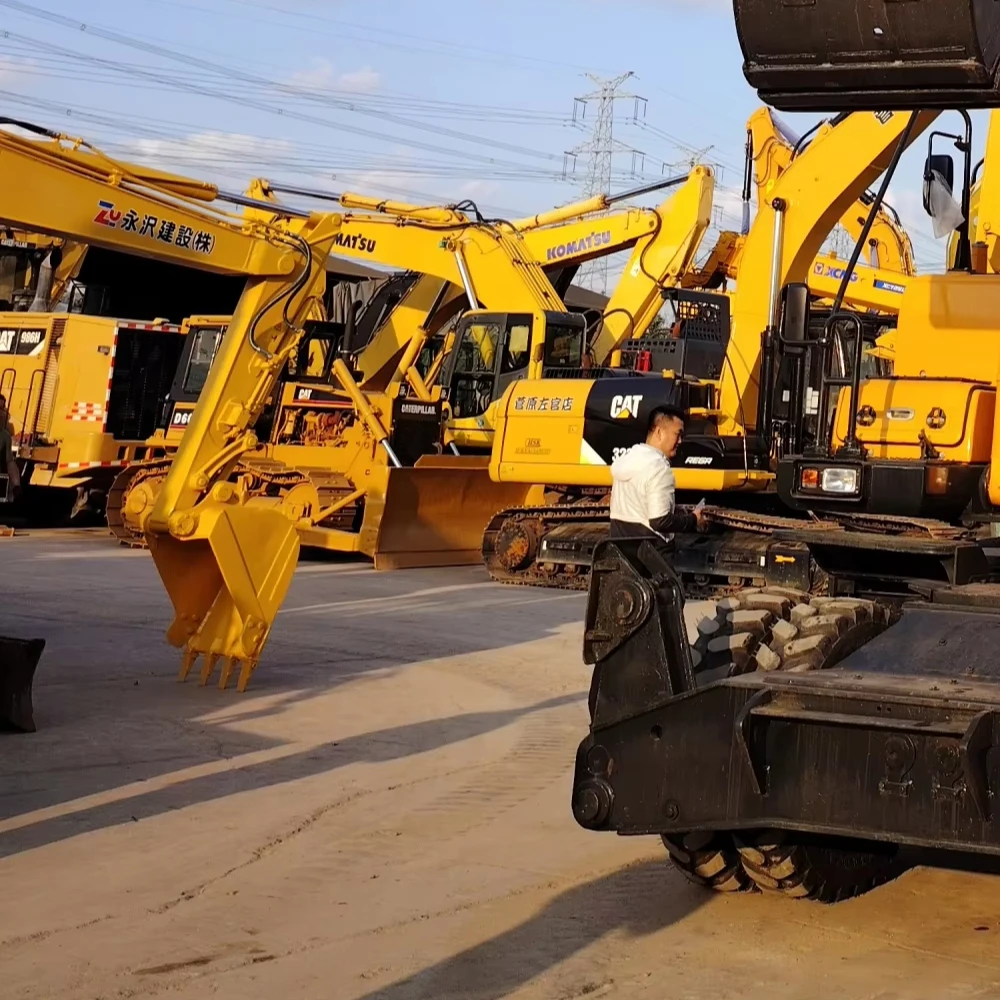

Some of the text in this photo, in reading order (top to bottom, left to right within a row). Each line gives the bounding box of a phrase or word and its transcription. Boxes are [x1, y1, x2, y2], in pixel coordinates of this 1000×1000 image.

[546, 230, 611, 261] KOMATSU
[0, 330, 16, 352] AT
[298, 388, 313, 400] CAT
[401, 403, 437, 415] CATERPILLAR
[610, 394, 643, 419] CAT
